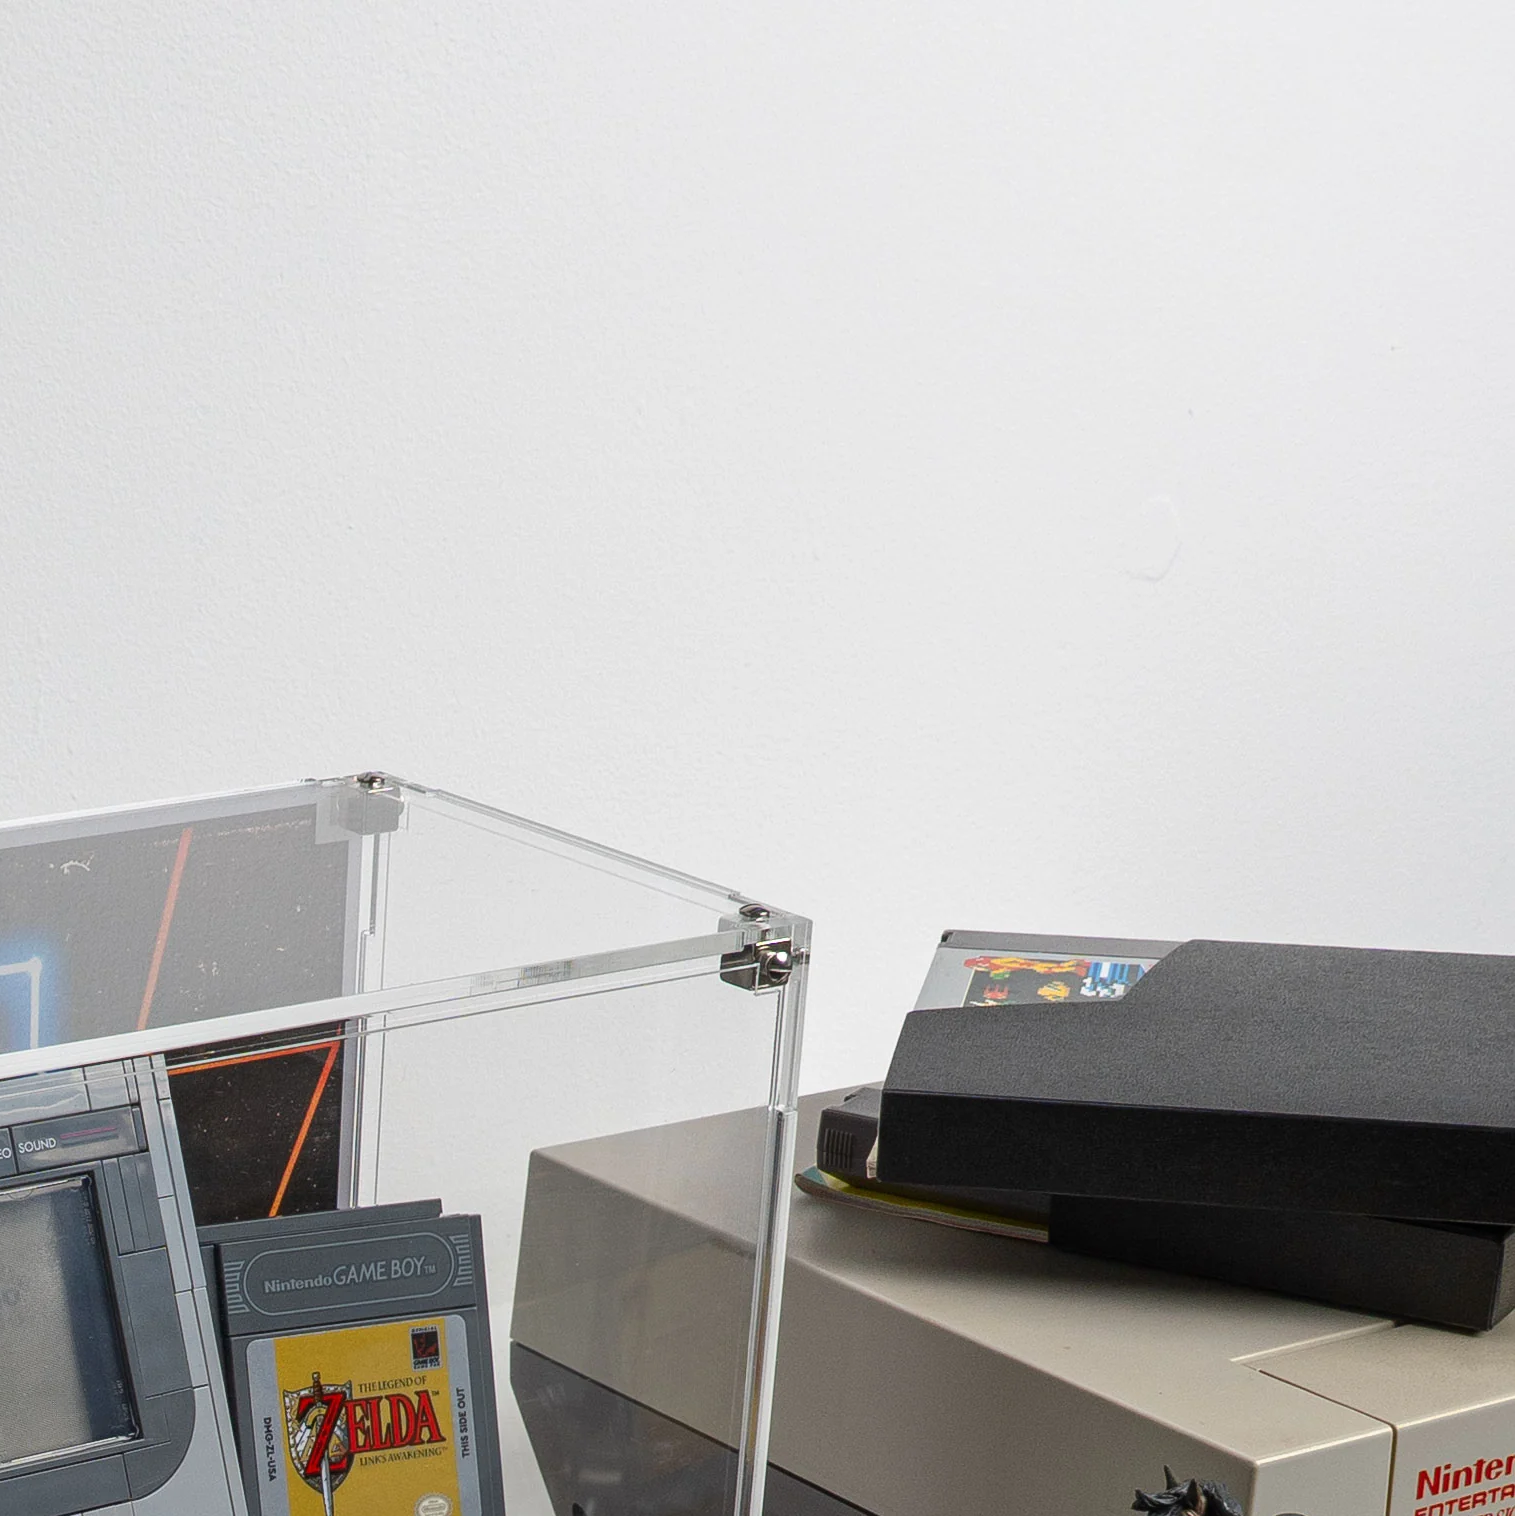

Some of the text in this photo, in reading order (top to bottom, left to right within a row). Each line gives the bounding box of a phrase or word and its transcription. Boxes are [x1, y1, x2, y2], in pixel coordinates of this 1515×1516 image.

[18, 1137, 57, 1154] SOUND
[264, 1274, 333, 1294] Nintendo
[333, 1260, 387, 1286] GAME
[358, 1376, 427, 1394] THE LEGEND OF
[455, 1387, 471, 1459] THIS SIDE OUT
[263, 1416, 278, 1482] DMG-ZL-USA
